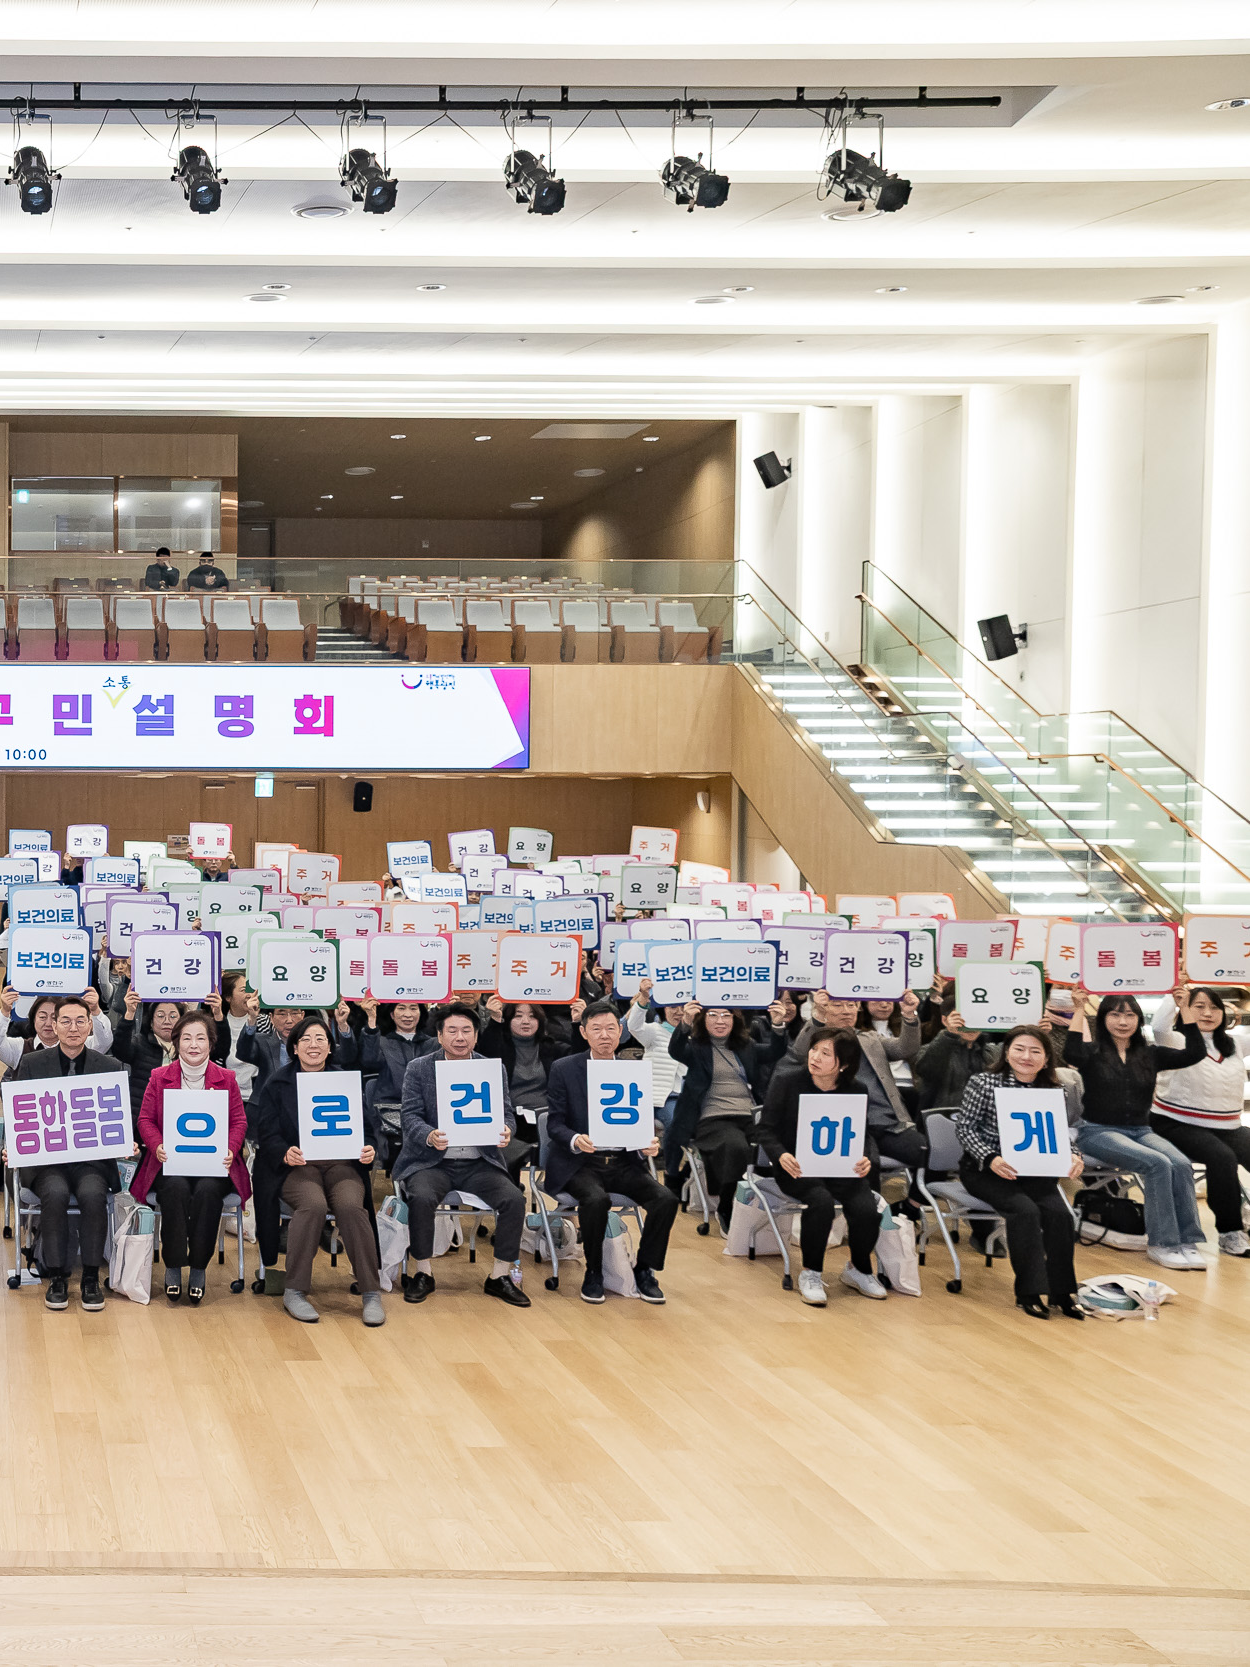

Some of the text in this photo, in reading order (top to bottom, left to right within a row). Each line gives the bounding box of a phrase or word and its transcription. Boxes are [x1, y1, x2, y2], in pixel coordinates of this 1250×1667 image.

[102, 674, 132, 690] 소통
[5, 748, 48, 761] 10:00
[393, 855, 430, 866] 보건의료
[96, 872, 136, 884] 보건의료
[424, 887, 464, 898] 보건의료
[17, 908, 75, 924] 보건의료
[540, 918, 595, 933] 보건의료
[16, 951, 85, 970] 보건의료
[700, 966, 771, 983] 보건의료
[450, 1081, 493, 1125] 건
[600, 1082, 644, 1125] 강
[12, 1083, 126, 1155] 통합돌봄
[311, 1094, 353, 1137] 로
[174, 1112, 218, 1154] 으
[810, 1115, 856, 1157] 하
[1010, 1110, 1059, 1154] 게
